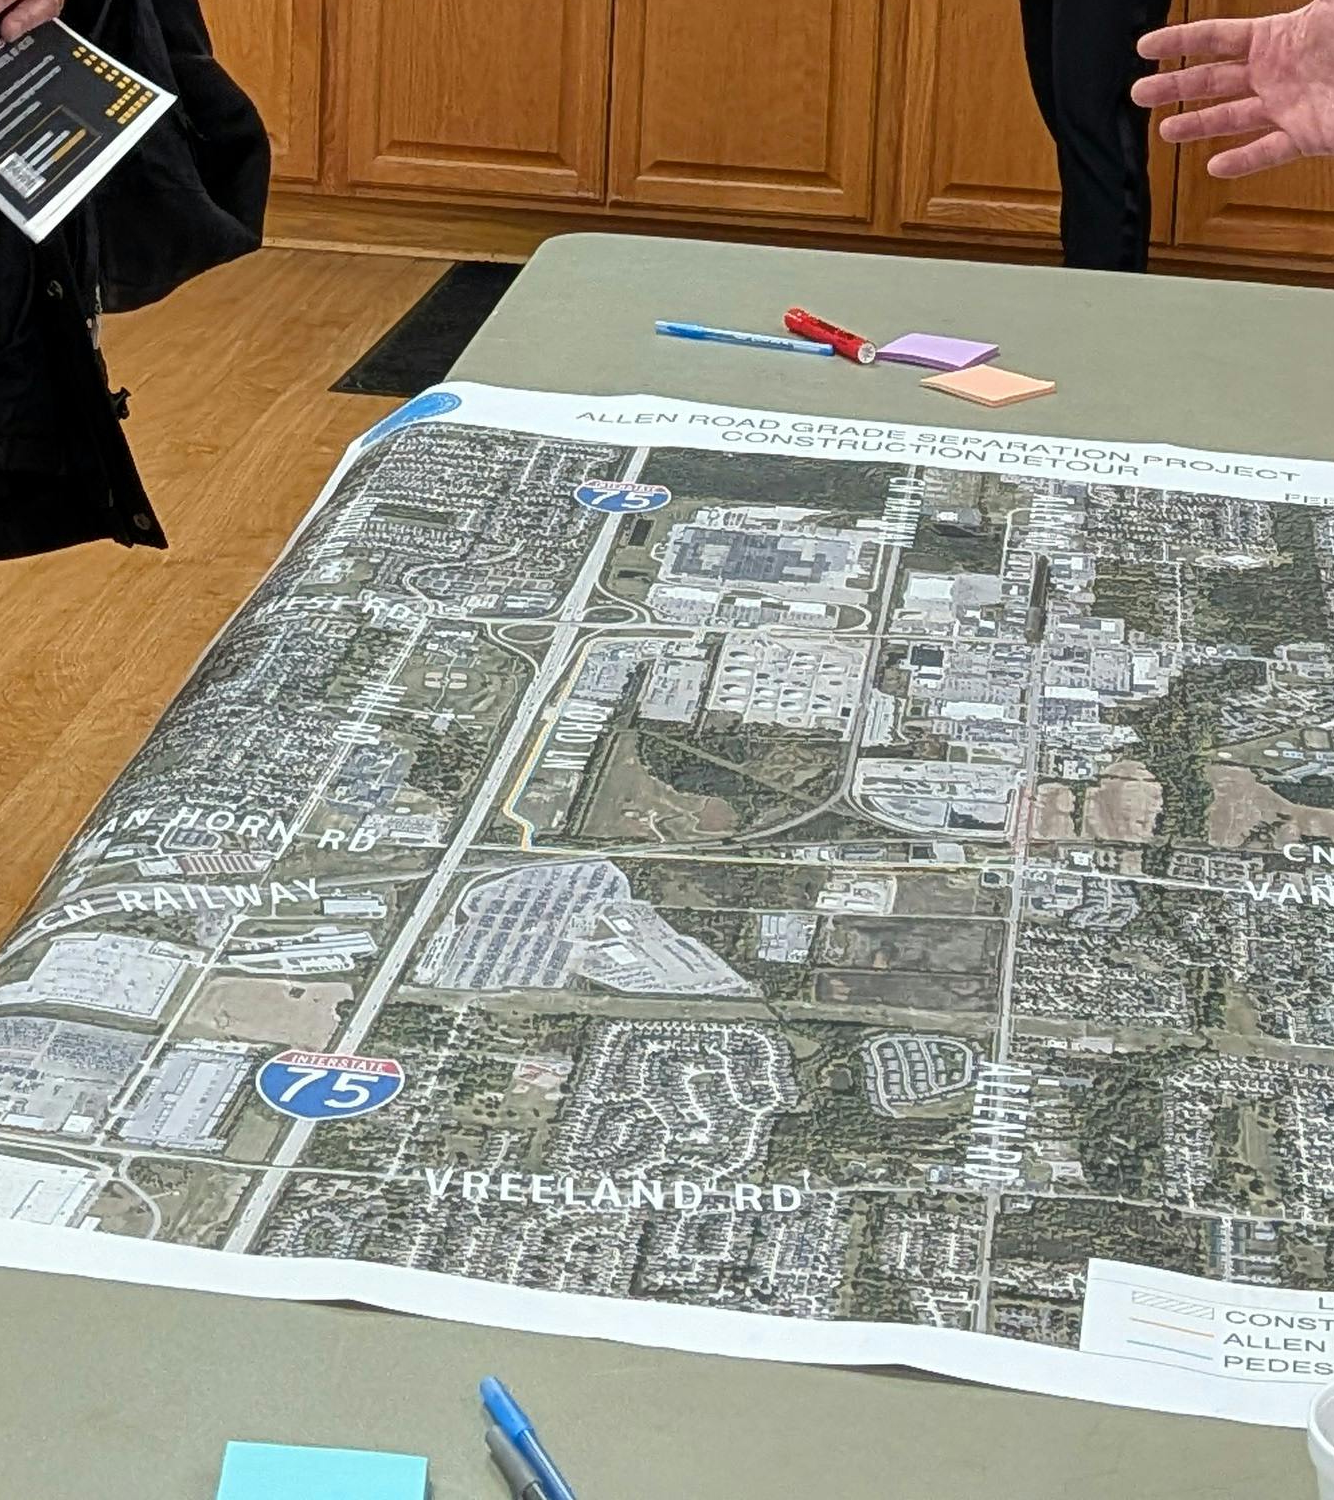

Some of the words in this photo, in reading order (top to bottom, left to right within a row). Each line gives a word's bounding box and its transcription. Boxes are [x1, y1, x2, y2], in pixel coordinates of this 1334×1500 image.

[576, 411, 679, 425] ALLEN
[688, 414, 781, 430] ROAD
[792, 422, 907, 439] GRADE
[919, 432, 1131, 463] SEPARATION
[1142, 454, 1302, 482] PROJECT
[721, 431, 987, 463] CONSTRUCTION
[998, 452, 1141, 477] DETOUR
[591, 489, 654, 508] 75
[347, 682, 408, 715] HALL
[333, 720, 382, 745] RD
[555, 702, 614, 743] FORD
[541, 750, 592, 770] LN
[175, 806, 295, 845] HORN
[317, 828, 379, 853] RD
[36, 899, 95, 932] CN
[117, 877, 322, 914] RAILWAY
[290, 1053, 388, 1073] INTERSTATE
[279, 1067, 382, 1109] 75
[970, 1061, 1032, 1138] ALLEN
[964, 1147, 1022, 1181] RD
[425, 1167, 704, 1212] VREELAND
[735, 1182, 803, 1213] RD
[1223, 1332, 1326, 1353] ALLEN
